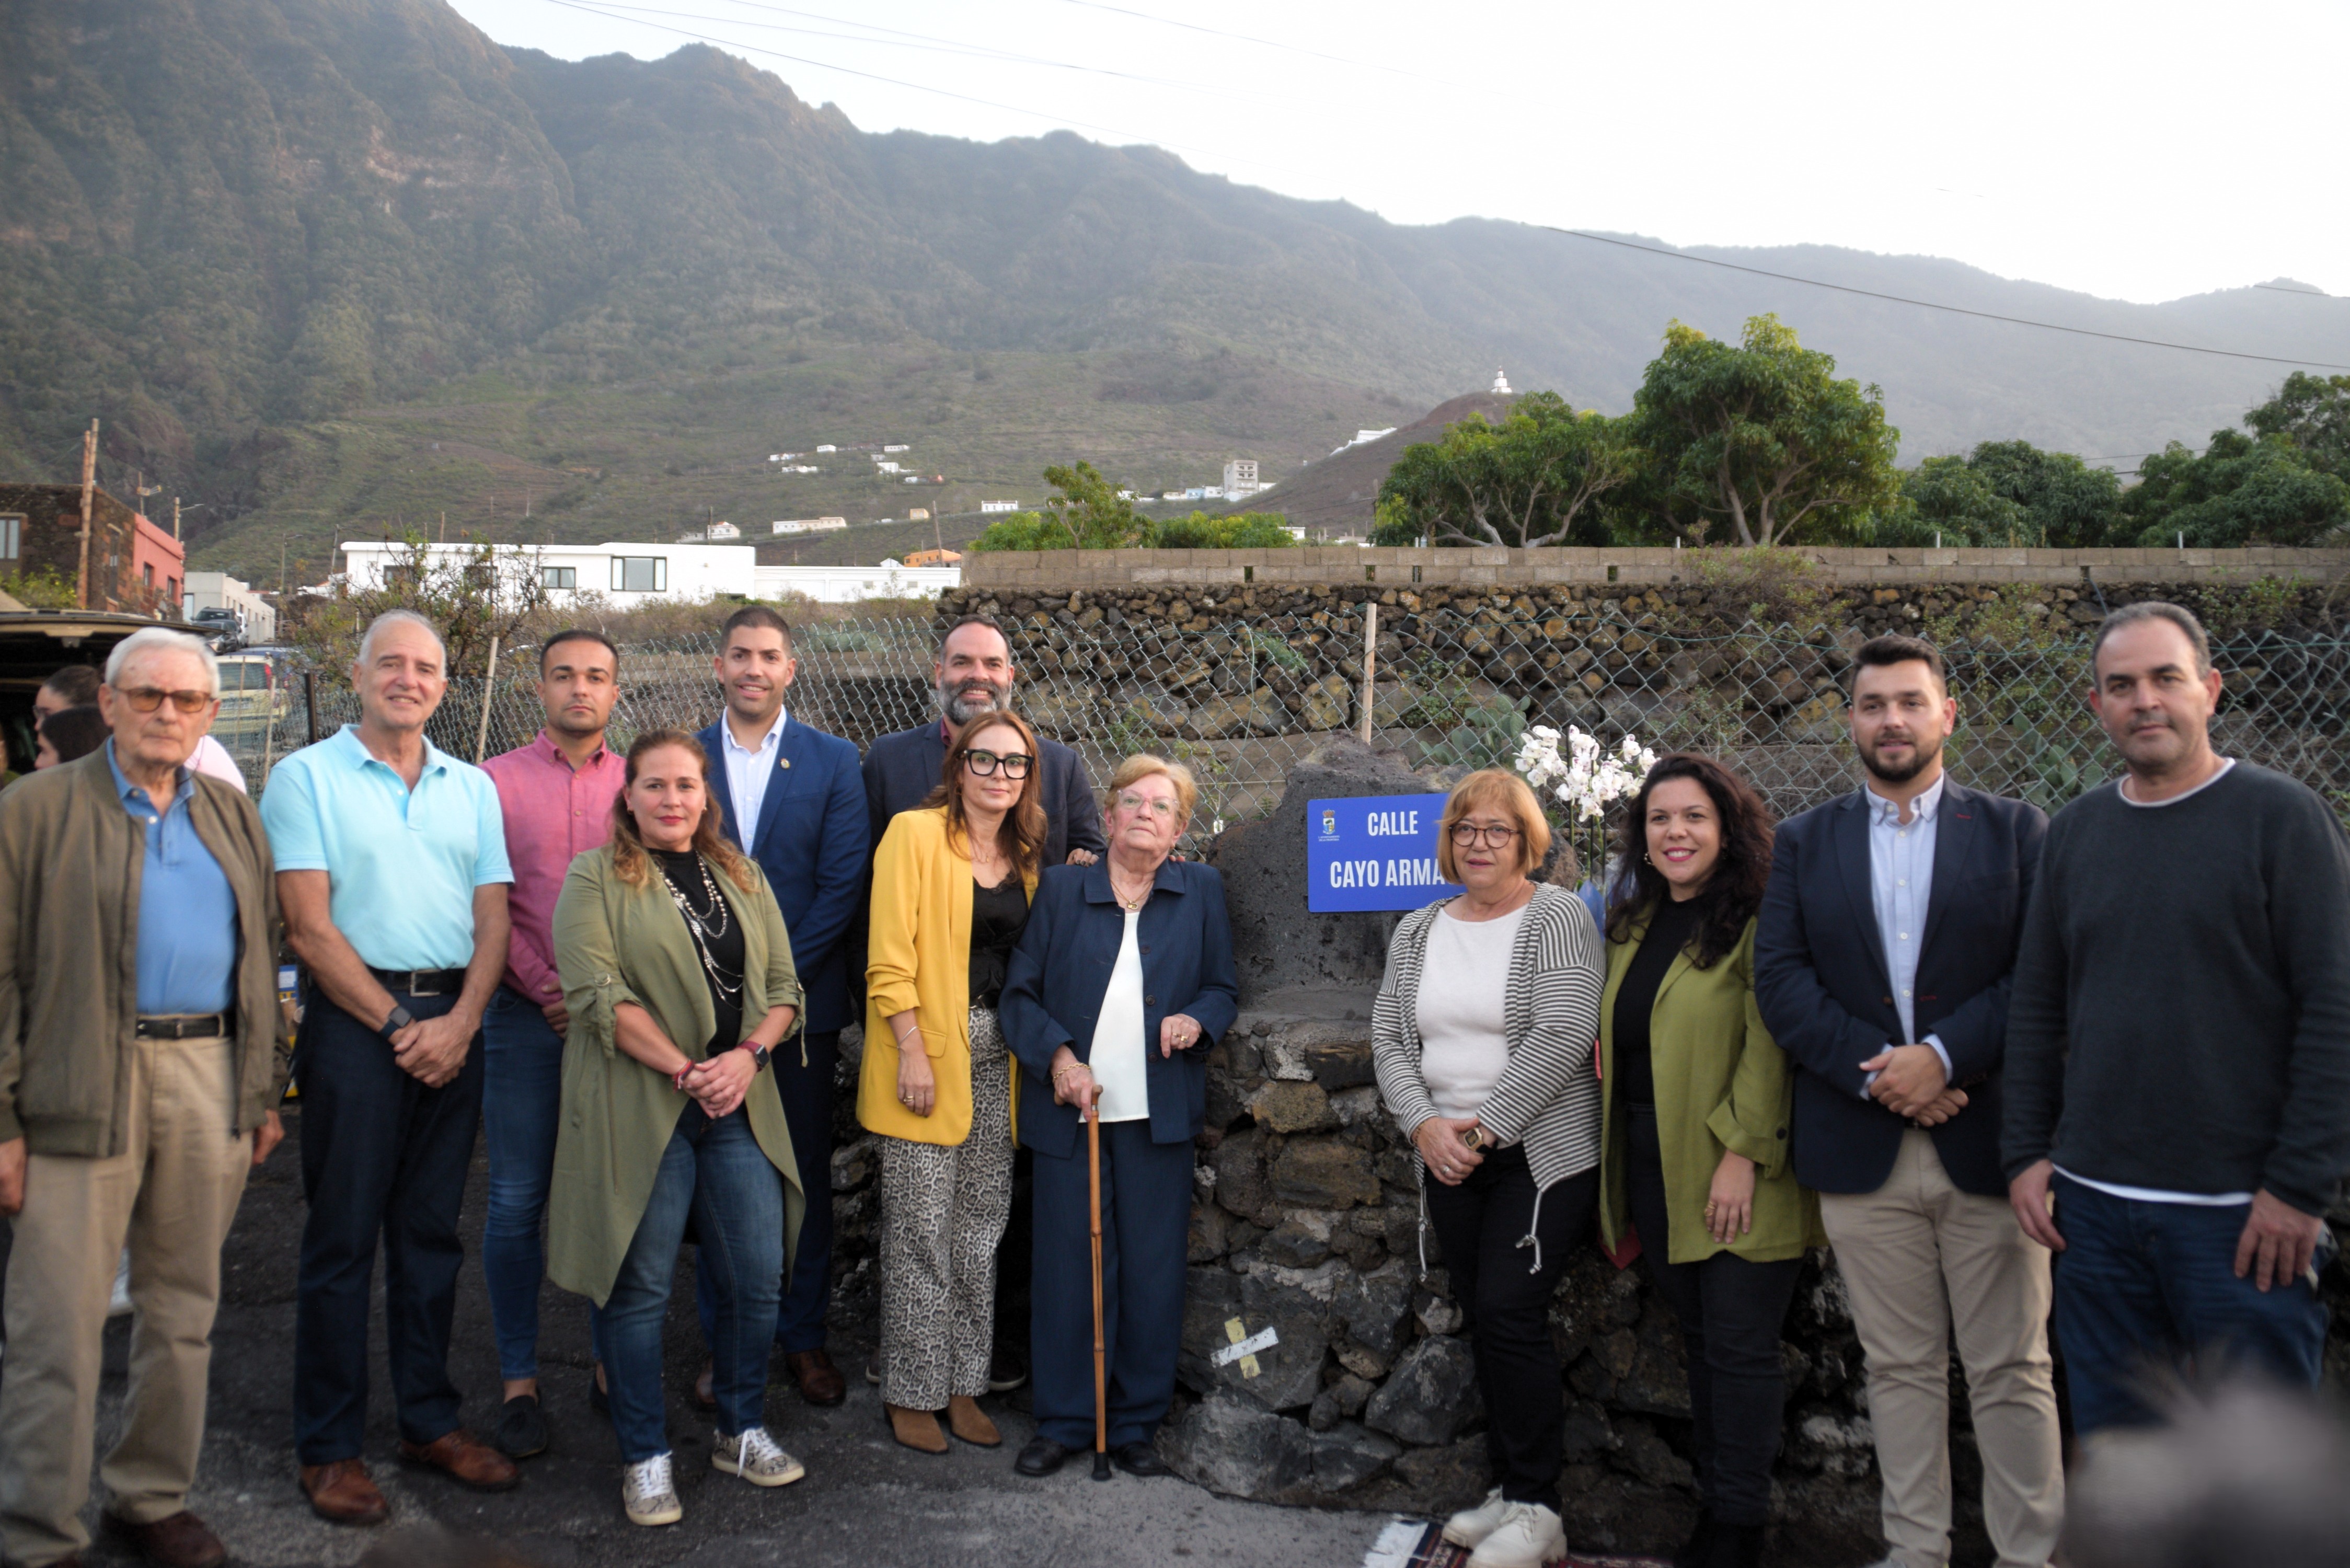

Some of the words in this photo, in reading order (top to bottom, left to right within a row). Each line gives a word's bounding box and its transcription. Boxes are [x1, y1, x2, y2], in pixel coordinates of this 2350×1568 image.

[1368, 811, 1418, 836] CALLE
[1330, 860, 1379, 888] CAYO
[1385, 858, 1454, 886] ARMA
